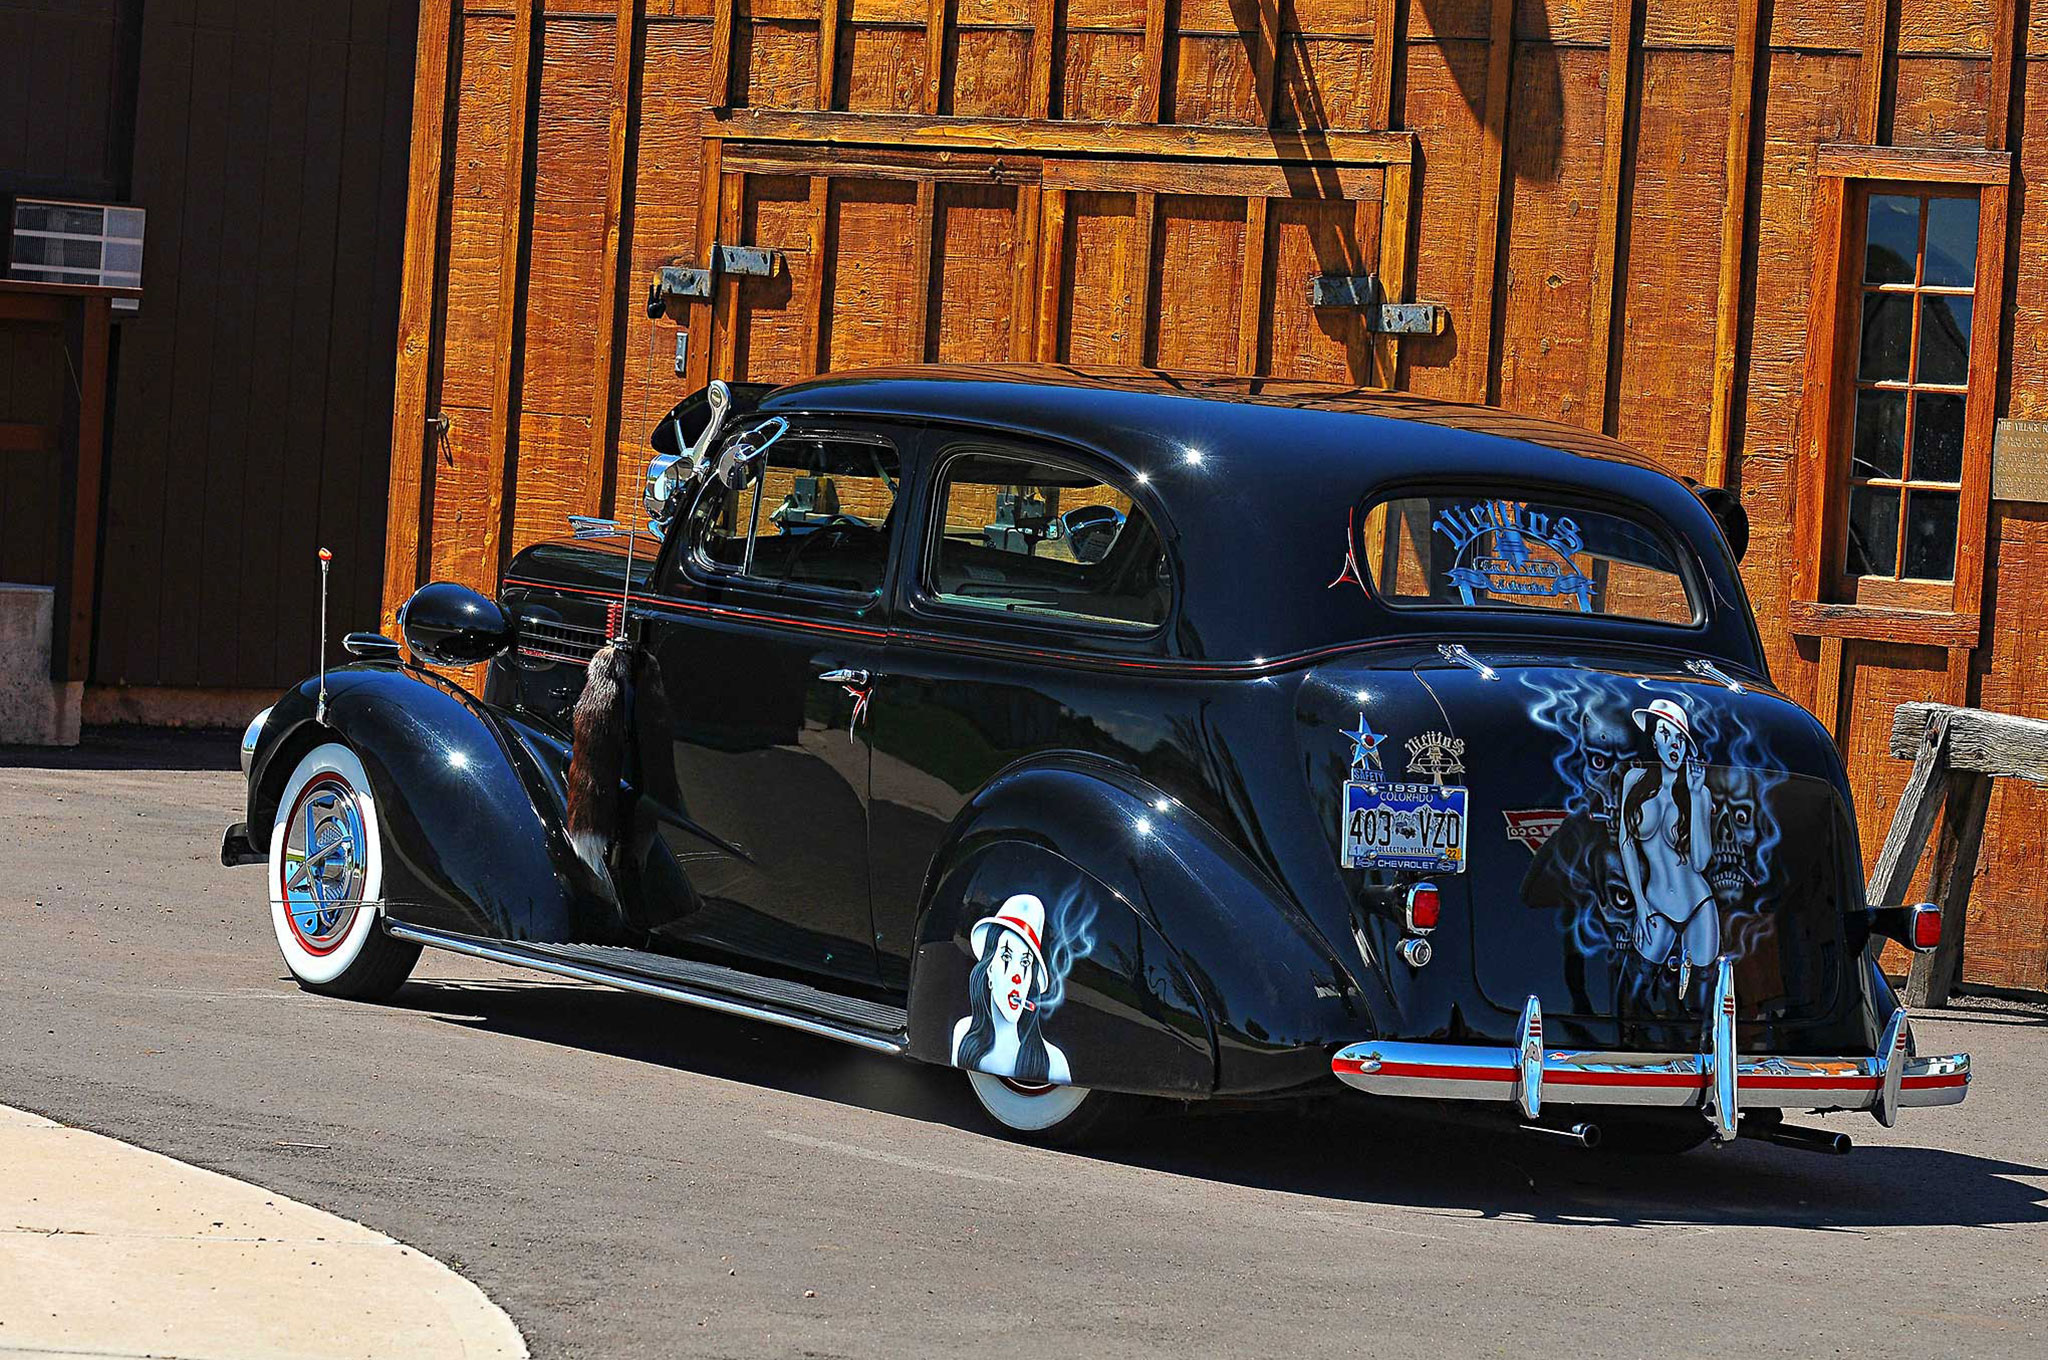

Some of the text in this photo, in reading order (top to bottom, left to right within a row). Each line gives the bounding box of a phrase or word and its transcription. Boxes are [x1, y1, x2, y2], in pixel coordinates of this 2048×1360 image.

[2000, 421, 2011, 431] THE
[2014, 422, 2039, 433] VILLAGE
[1353, 769, 1384, 783] SAFETY
[1379, 791, 1434, 803] COLORADO
[1350, 810, 1392, 846] 403
[1375, 846, 1435, 855] COLLECTOR VEHICLE
[1447, 849, 1457, 859] 22
[1377, 860, 1435, 870] CHEVROLET
